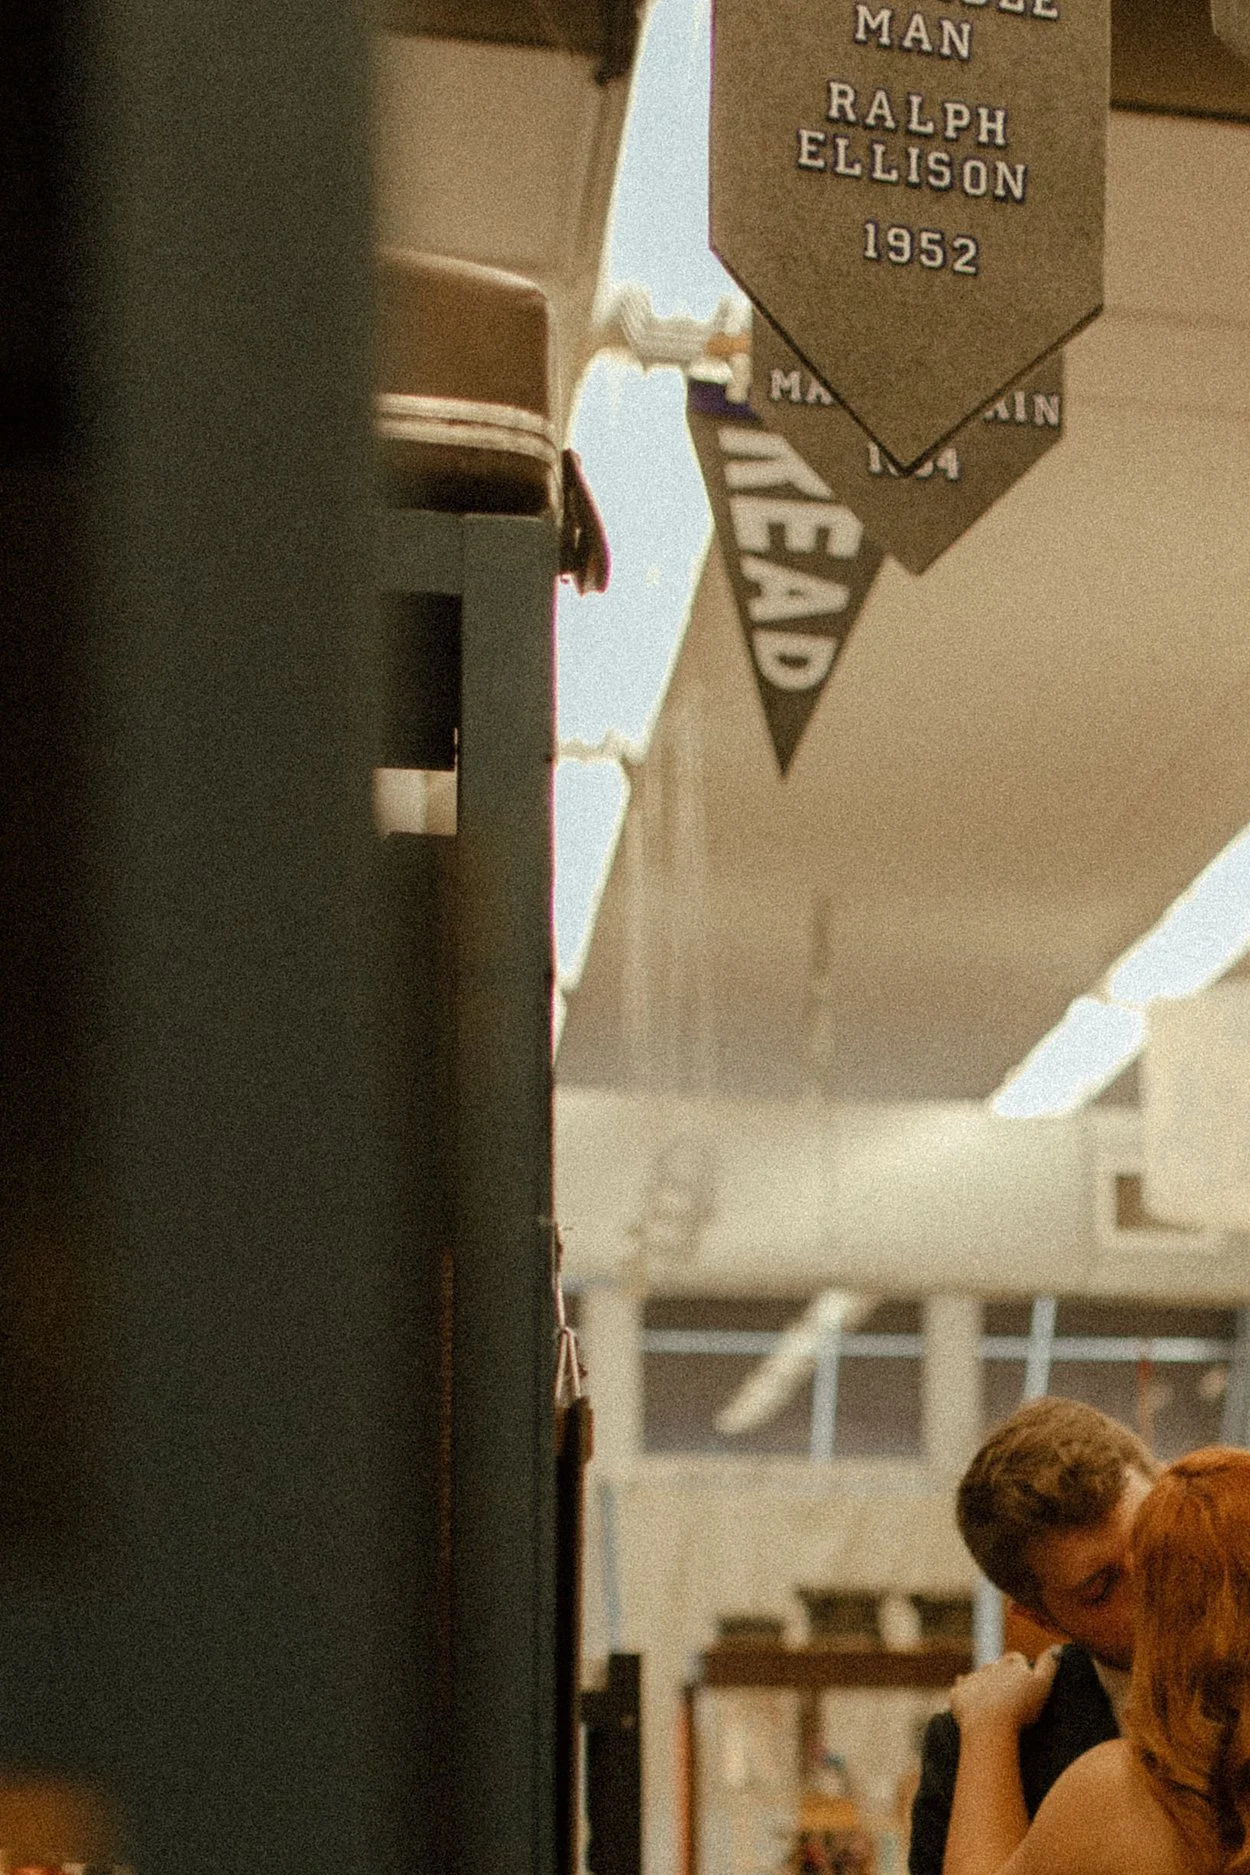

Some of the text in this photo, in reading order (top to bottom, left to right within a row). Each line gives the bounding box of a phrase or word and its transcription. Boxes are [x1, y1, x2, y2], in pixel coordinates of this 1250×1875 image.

[855, 4, 972, 58] MAN
[828, 81, 1005, 147] RALPH
[798, 128, 1026, 200] ELLISON
[864, 222, 978, 274] 1952
[770, 367, 836, 404] MA
